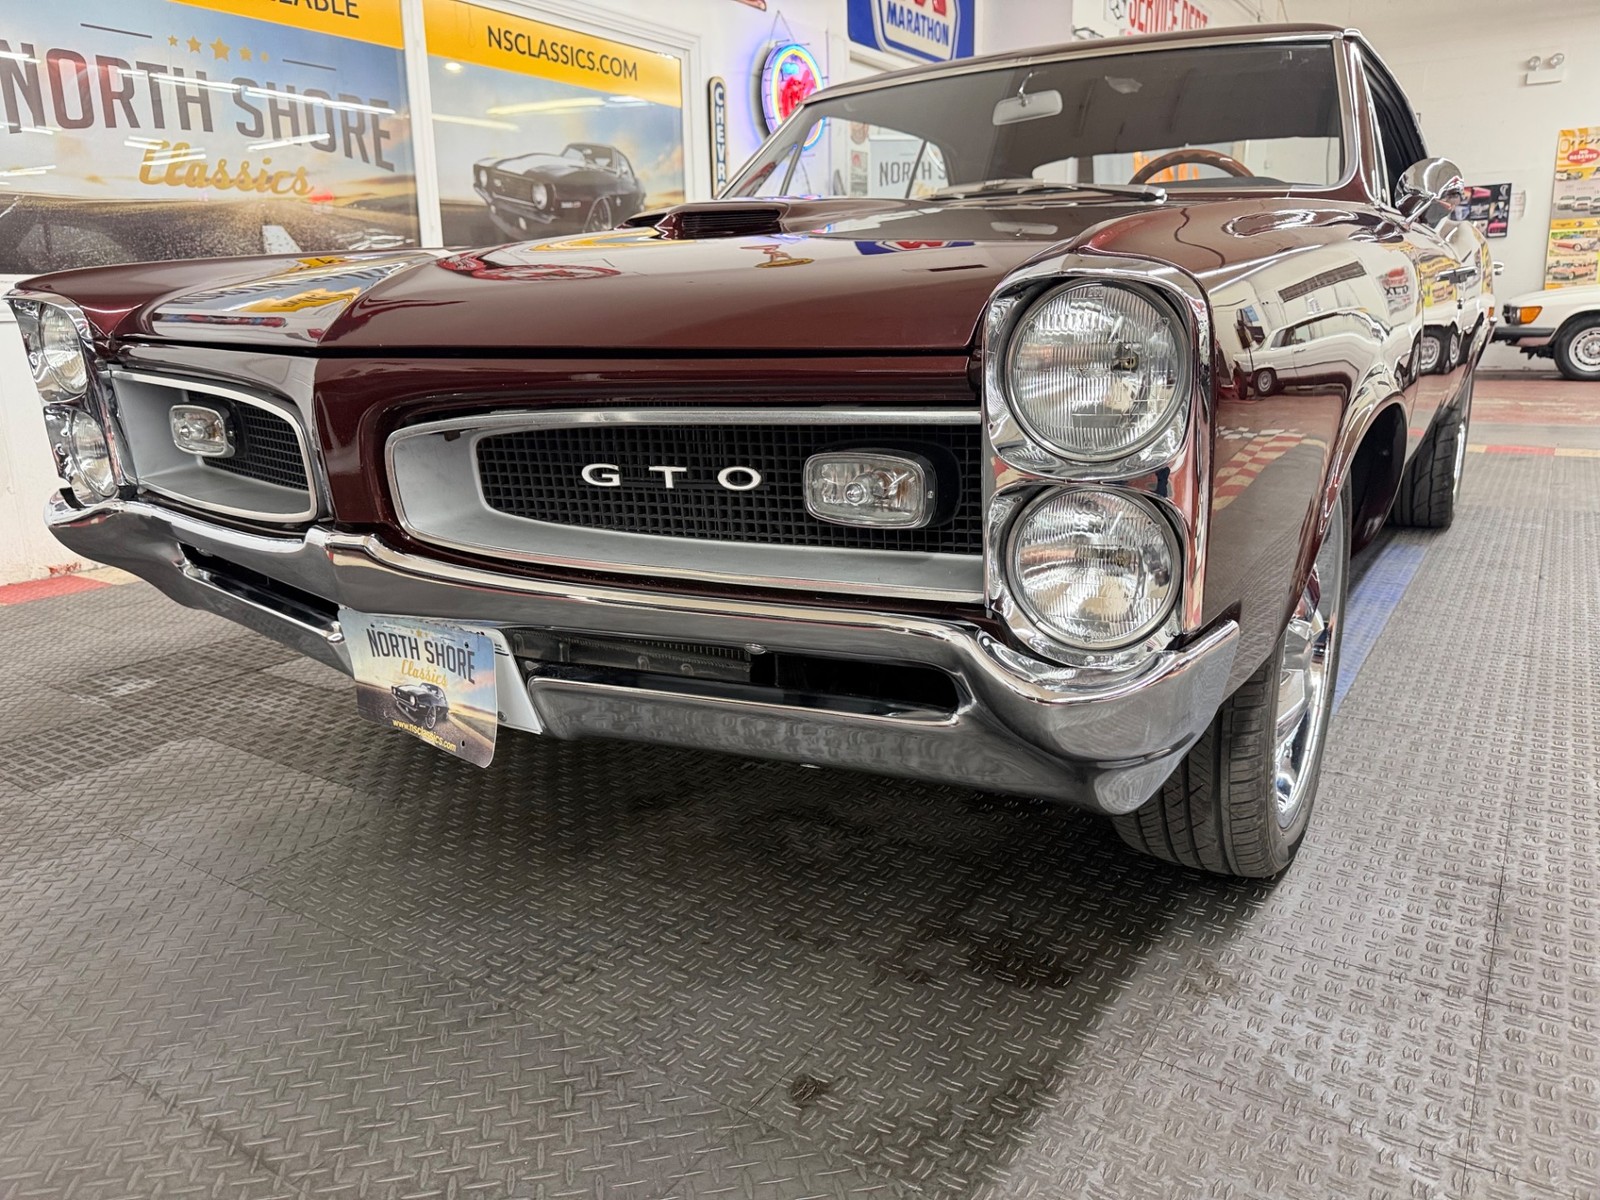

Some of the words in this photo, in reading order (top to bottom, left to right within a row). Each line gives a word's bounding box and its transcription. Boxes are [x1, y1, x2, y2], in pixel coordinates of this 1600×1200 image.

[886, 1, 950, 46] MARATHON
[488, 26, 638, 81] NSCLASSICS.COM
[0, 39, 214, 134] NORTH
[232, 77, 395, 172] SHORE
[139, 140, 315, 196] Classics
[366, 628, 421, 661] NORTH
[424, 640, 476, 685] SHORE
[401, 659, 448, 687] Classics
[392, 719, 457, 752] www.nsclassics.com
